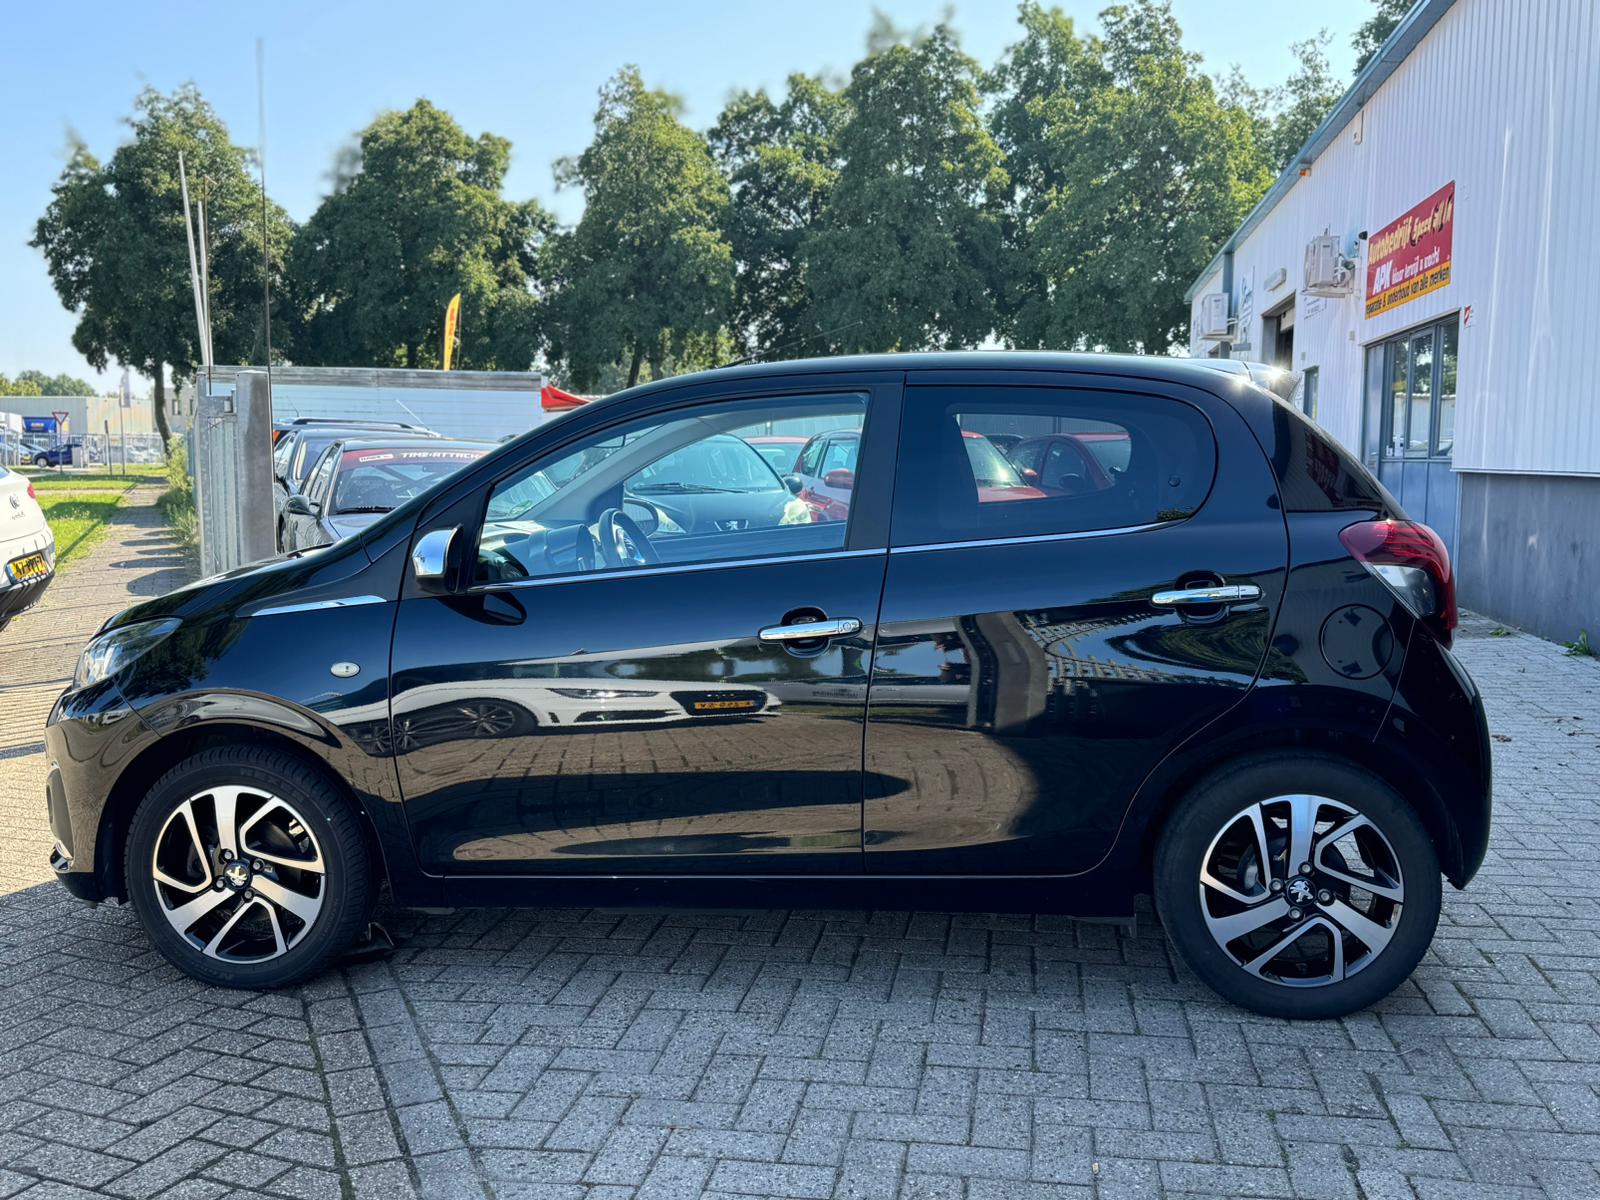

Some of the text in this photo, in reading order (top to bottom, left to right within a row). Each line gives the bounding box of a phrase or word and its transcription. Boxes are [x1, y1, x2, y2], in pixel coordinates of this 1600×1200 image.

[1368, 215, 1412, 265] Autobedrijf
[1373, 260, 1393, 295] APK
[1424, 246, 1441, 270] wacht
[1387, 285, 1411, 305] onderhoud
[1411, 280, 1420, 296] van
[1420, 273, 1429, 292] alle
[1429, 266, 1450, 287] merken
